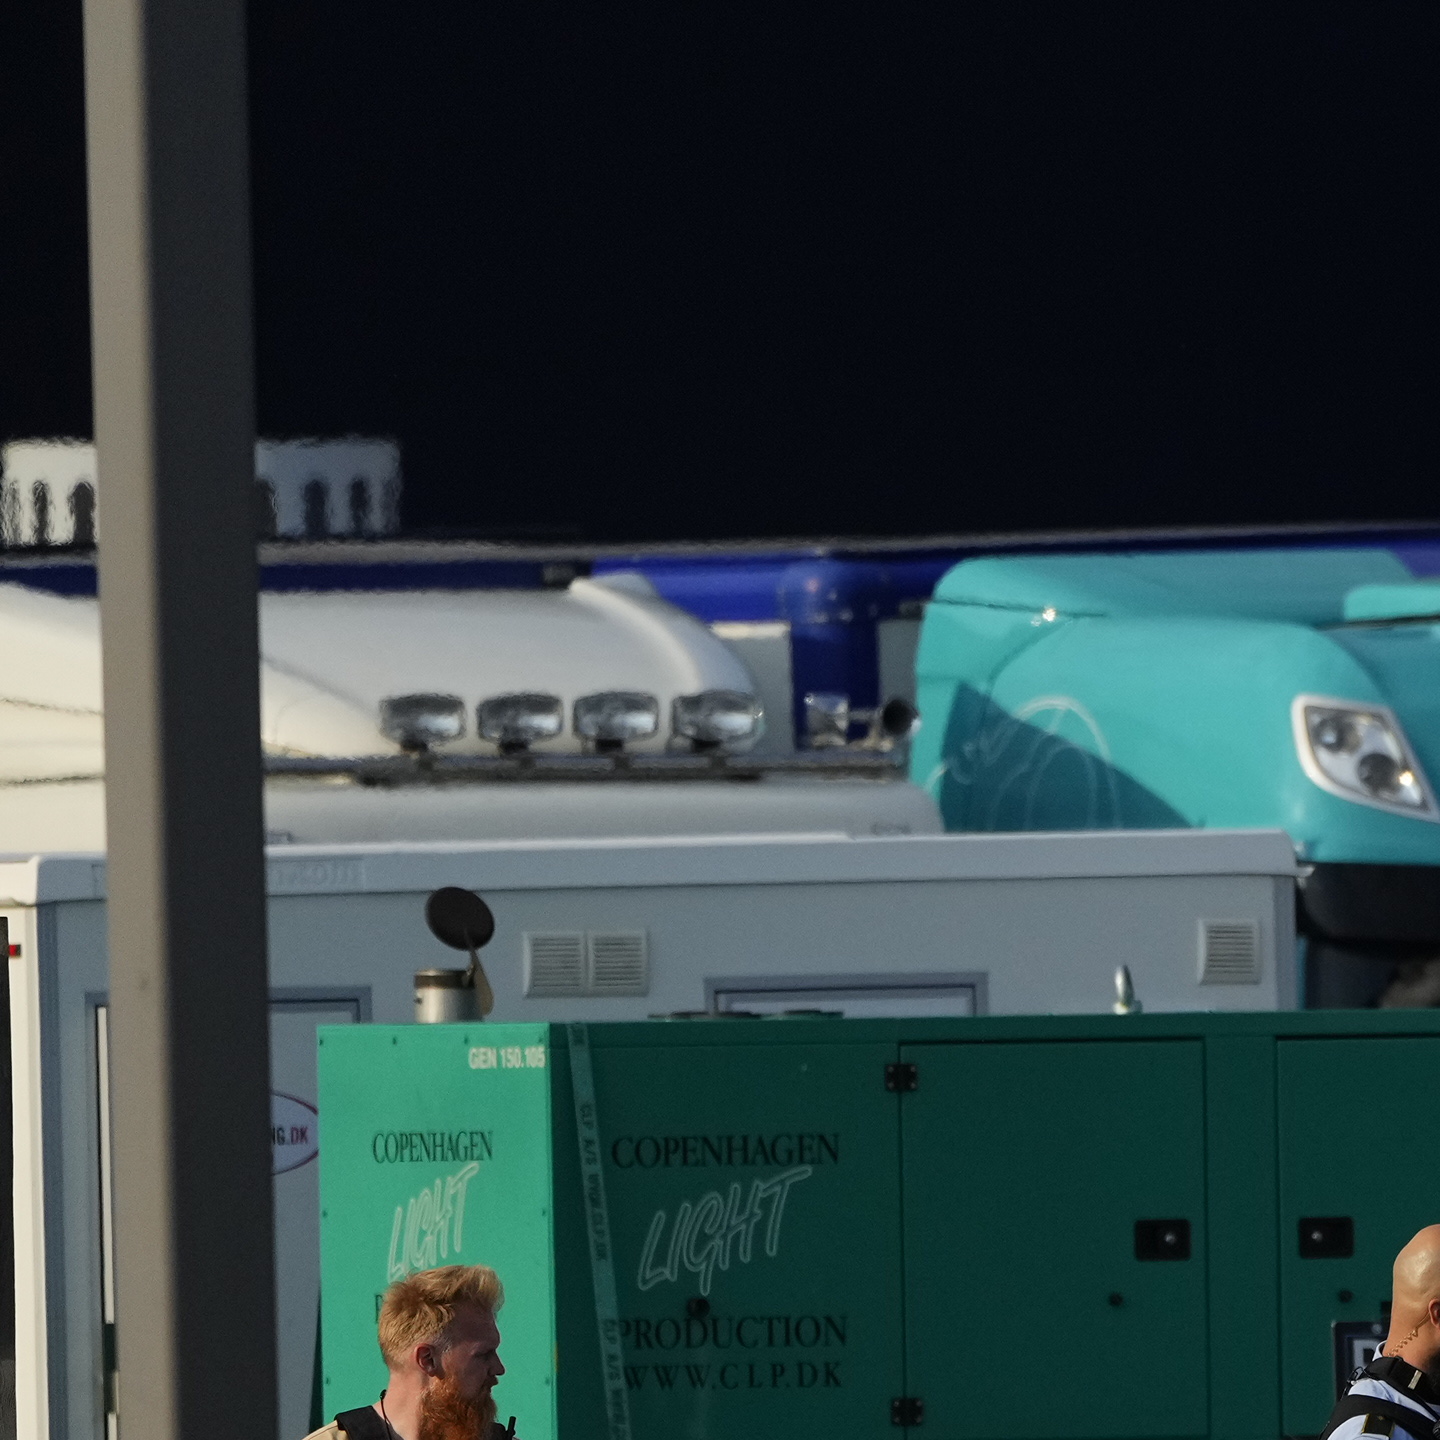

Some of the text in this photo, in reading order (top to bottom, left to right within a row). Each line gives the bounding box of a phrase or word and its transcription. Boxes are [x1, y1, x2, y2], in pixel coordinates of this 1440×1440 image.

[469, 1046, 497, 1070] GEN
[373, 1131, 494, 1163] COPENHAGEN
[611, 1133, 840, 1169] COPENHAGEN
[388, 1162, 480, 1285] LIGHT
[638, 1164, 813, 1297] LIGHT
[617, 1315, 848, 1350] PRODUCTION
